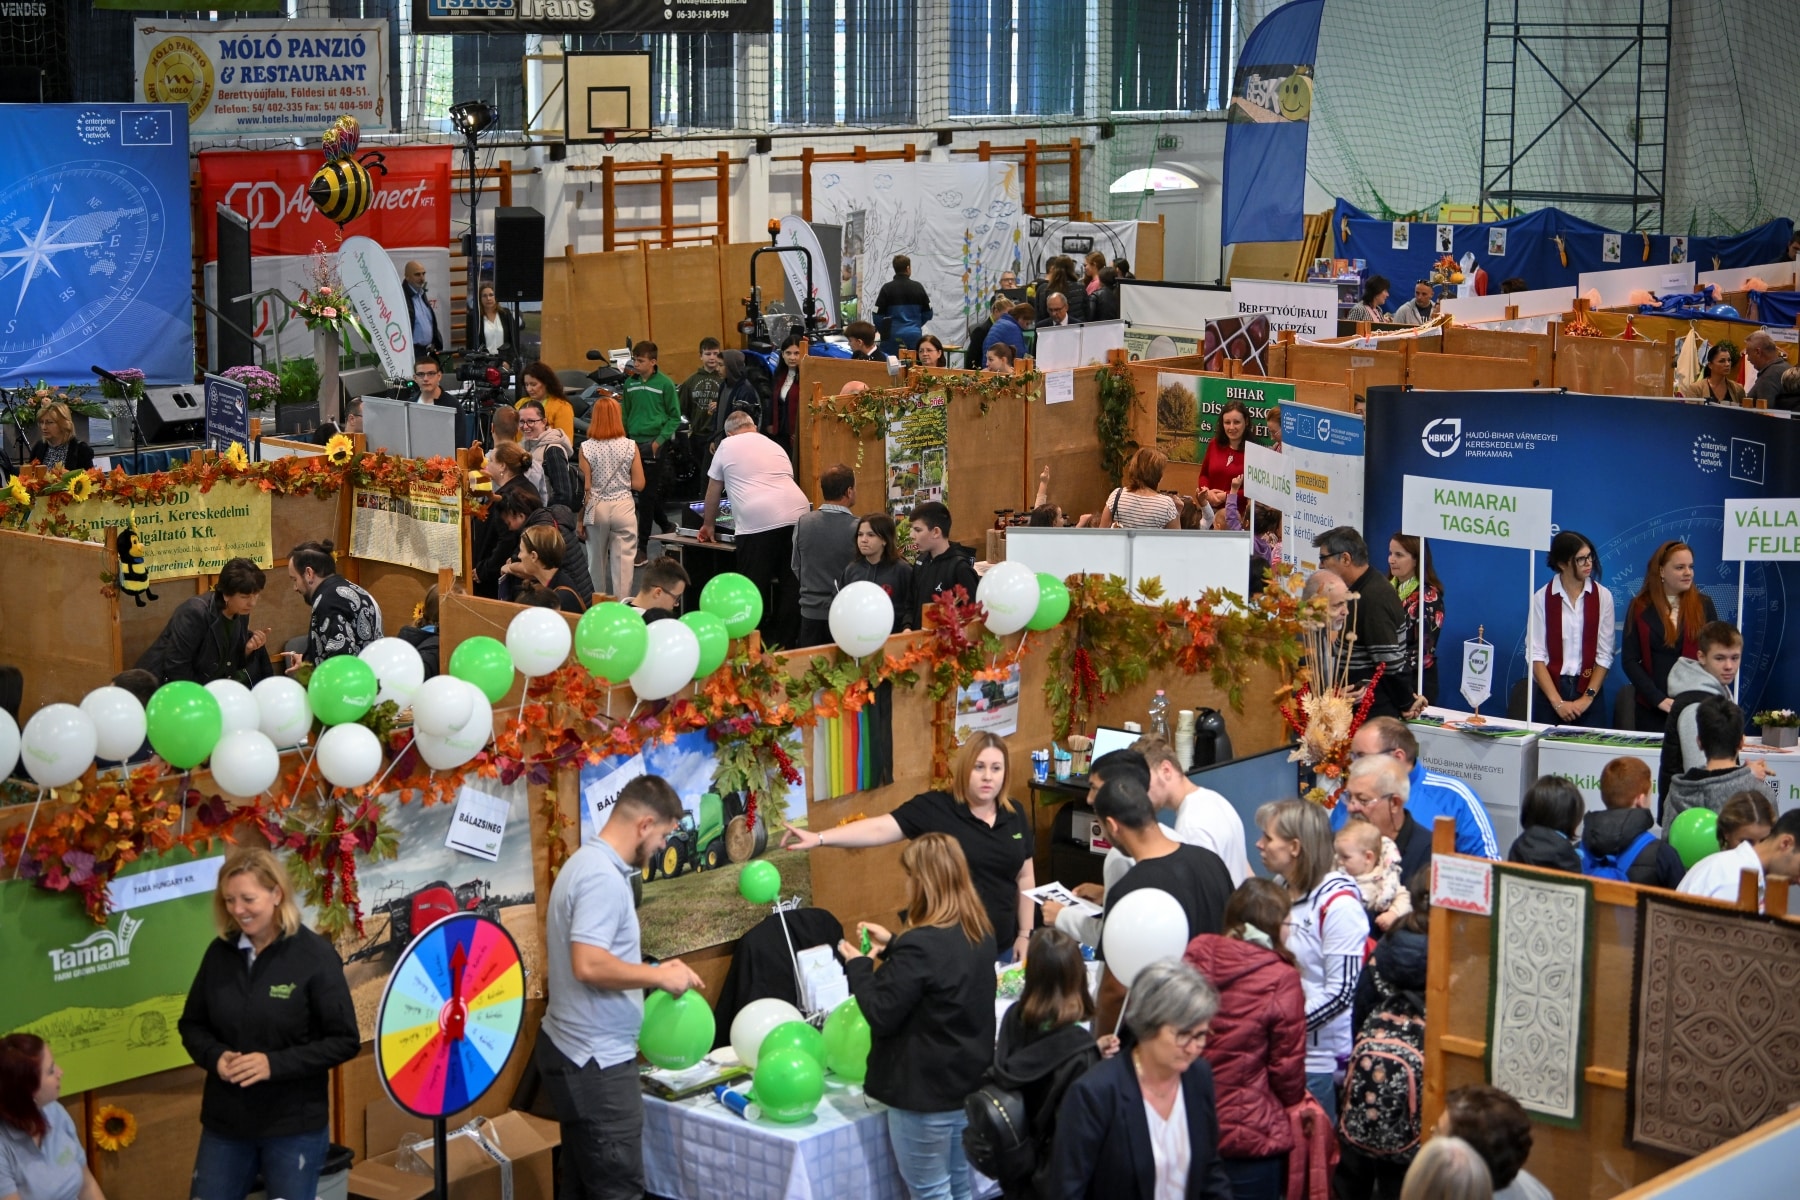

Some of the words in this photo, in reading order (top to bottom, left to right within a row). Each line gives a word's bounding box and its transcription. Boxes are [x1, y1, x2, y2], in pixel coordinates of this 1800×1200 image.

[676, 10, 729, 19] 06-30-518-9194
[219, 33, 282, 60] MÓLÓ
[287, 33, 366, 58] PANZIÓ
[220, 66, 235, 84] &
[240, 64, 367, 84] RESTAURANT
[218, 87, 288, 101] Berettyóújfalu,
[291, 86, 325, 98] Földesi
[327, 86, 337, 97] út
[339, 86, 371, 97] 49-51.
[214, 104, 250, 114] Telefon:
[267, 102, 303, 113] 402-335
[305, 102, 321, 112] Fax:
[338, 100, 373, 110] 404-509
[51, 183, 63, 194] N
[87, 196, 103, 209] NE
[286, 179, 427, 223] Agnect
[420, 196, 435, 207] KFT.
[109, 234, 122, 248] E
[5, 319, 17, 334] S
[1270, 322, 1316, 334] KKÉPZÉSI
[1226, 387, 1265, 401] BIHAR
[1428, 433, 1453, 443] HBKIK
[1465, 431, 1514, 440] HAJDÚ-BIHAR
[1515, 432, 1558, 442] VÁRMEGYEI
[1465, 441, 1524, 449] KERESKEDELMI
[1525, 441, 1535, 450] ÉS
[1700, 442, 1727, 452] enterprise
[1465, 450, 1513, 458] IPARKAMARA
[1700, 450, 1720, 459] europe
[1700, 458, 1723, 467] network
[1247, 465, 1270, 487] PIACRA
[1271, 475, 1291, 496] JUTÁS
[1295, 490, 1317, 506] ekedés
[1434, 488, 1517, 513] KAMARAI
[168, 505, 249, 521] Kereskedelmi
[1303, 509, 1334, 529] innováció
[1735, 507, 1800, 527] VÁLLA
[1440, 514, 1510, 537] TAGSÁG
[138, 526, 187, 546] lgáltató
[192, 526, 217, 538] Kft.
[145, 559, 194, 573] rtnereinek
[1612, 564, 1633, 584] NW
[1716, 562, 1732, 579] NE
[1422, 756, 1464, 769] HAJDÚ-BIHAR
[1465, 763, 1504, 774] VÁRMEGYEI
[458, 811, 502, 834] BÁLAZSINEG
[134, 885, 151, 895] TAMA
[152, 879, 183, 891] HUNGARY
[48, 942, 114, 972] Tama
[54, 972, 72, 983] FARM
[73, 967, 96, 978] GROWN
[97, 957, 130, 973] SOLUTIONS
